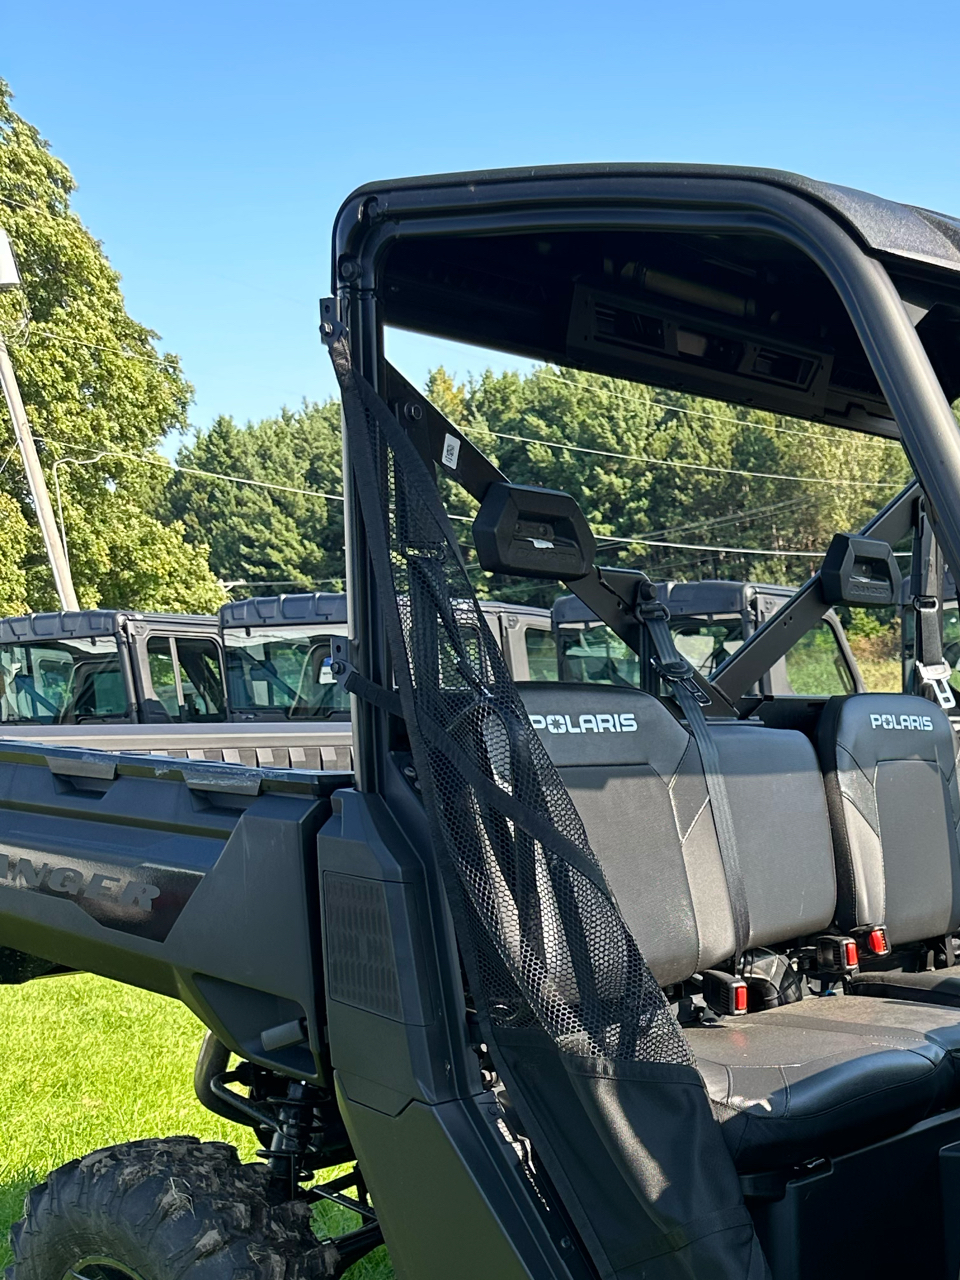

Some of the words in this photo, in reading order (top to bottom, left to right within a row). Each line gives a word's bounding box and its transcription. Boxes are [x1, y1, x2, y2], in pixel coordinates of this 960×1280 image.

[528, 713, 638, 734] POLARIS
[869, 713, 934, 731] POLARIS
[0, 852, 161, 912] NGER
